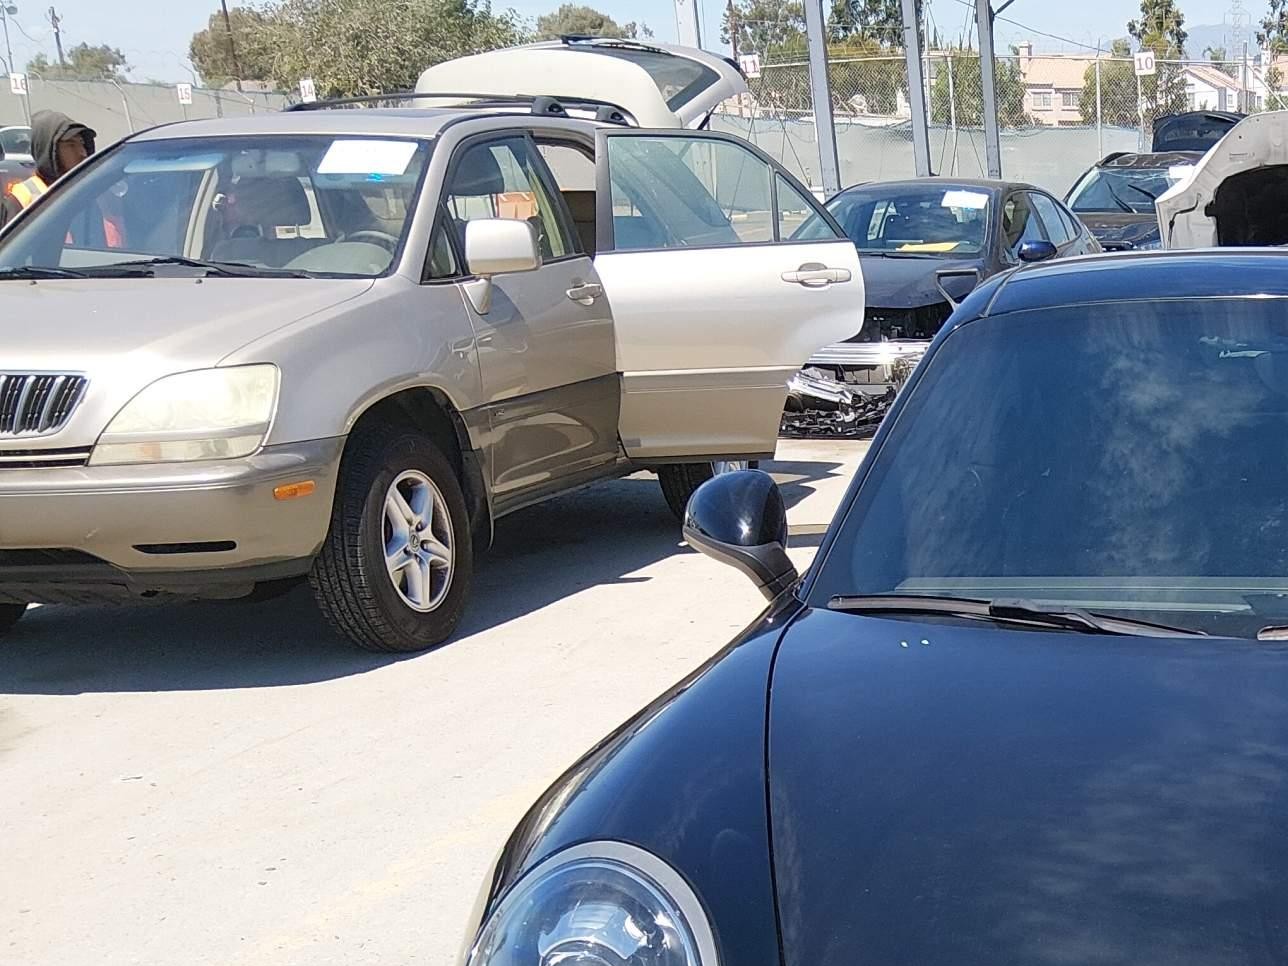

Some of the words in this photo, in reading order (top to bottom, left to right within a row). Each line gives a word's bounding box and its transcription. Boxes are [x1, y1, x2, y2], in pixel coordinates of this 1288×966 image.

[742, 59, 759, 73] 11
[1136, 57, 1154, 71] 10
[179, 87, 190, 100] 15
[302, 85, 314, 98] 14
